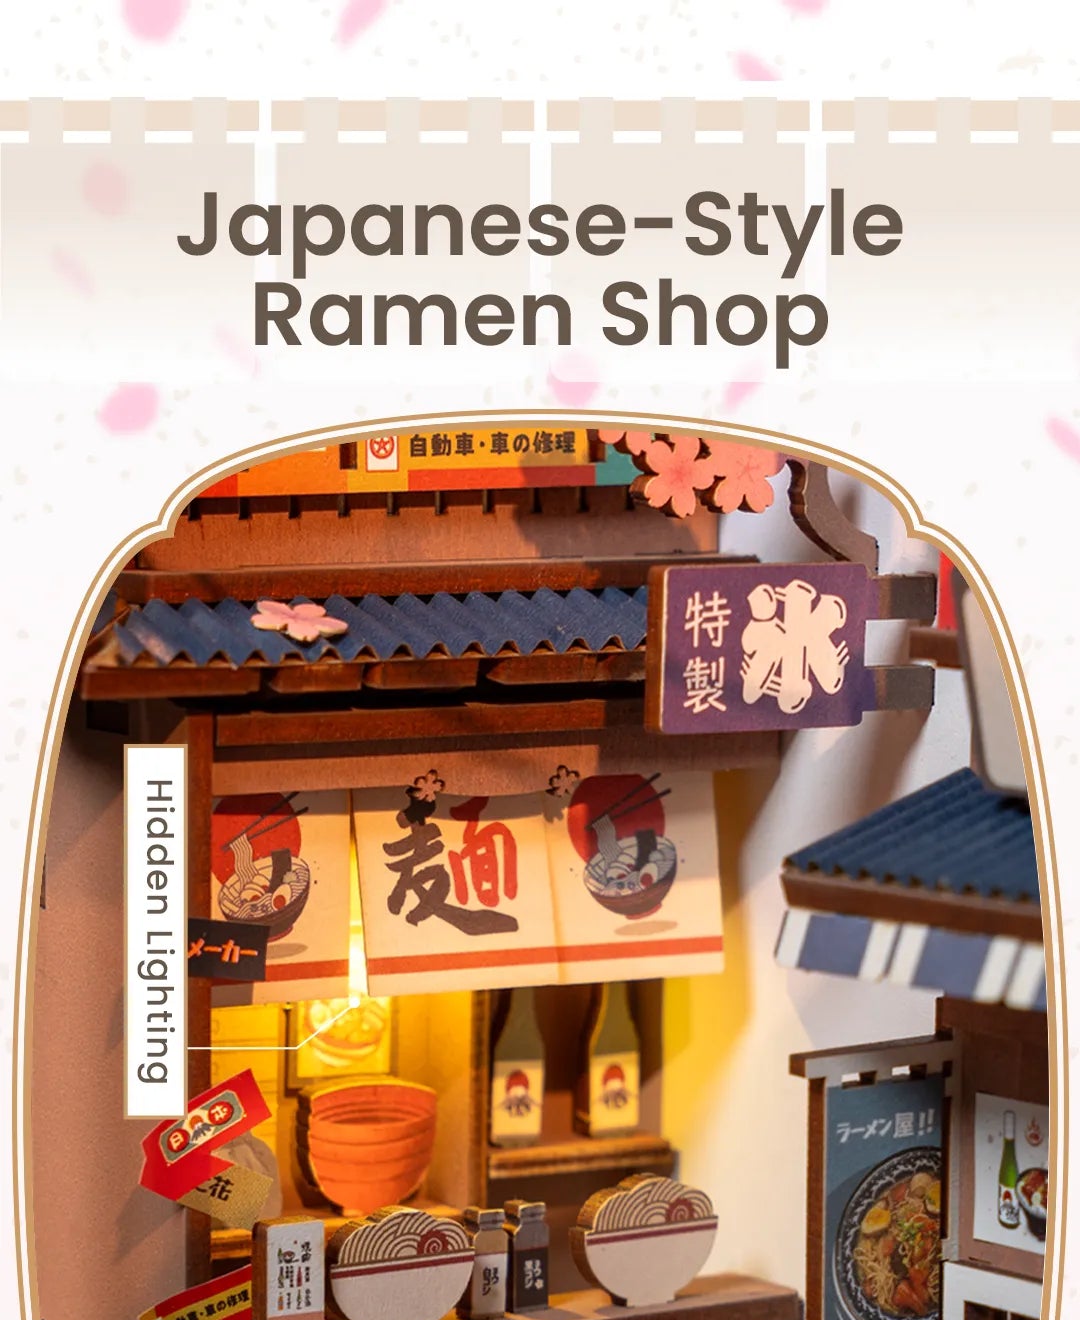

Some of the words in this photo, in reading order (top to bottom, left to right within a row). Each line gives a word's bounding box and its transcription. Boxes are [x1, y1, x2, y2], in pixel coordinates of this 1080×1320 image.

[410, 431, 575, 457] 自動車・車の修理
[683, 591, 731, 714] 特製
[740, 579, 849, 714] 氷
